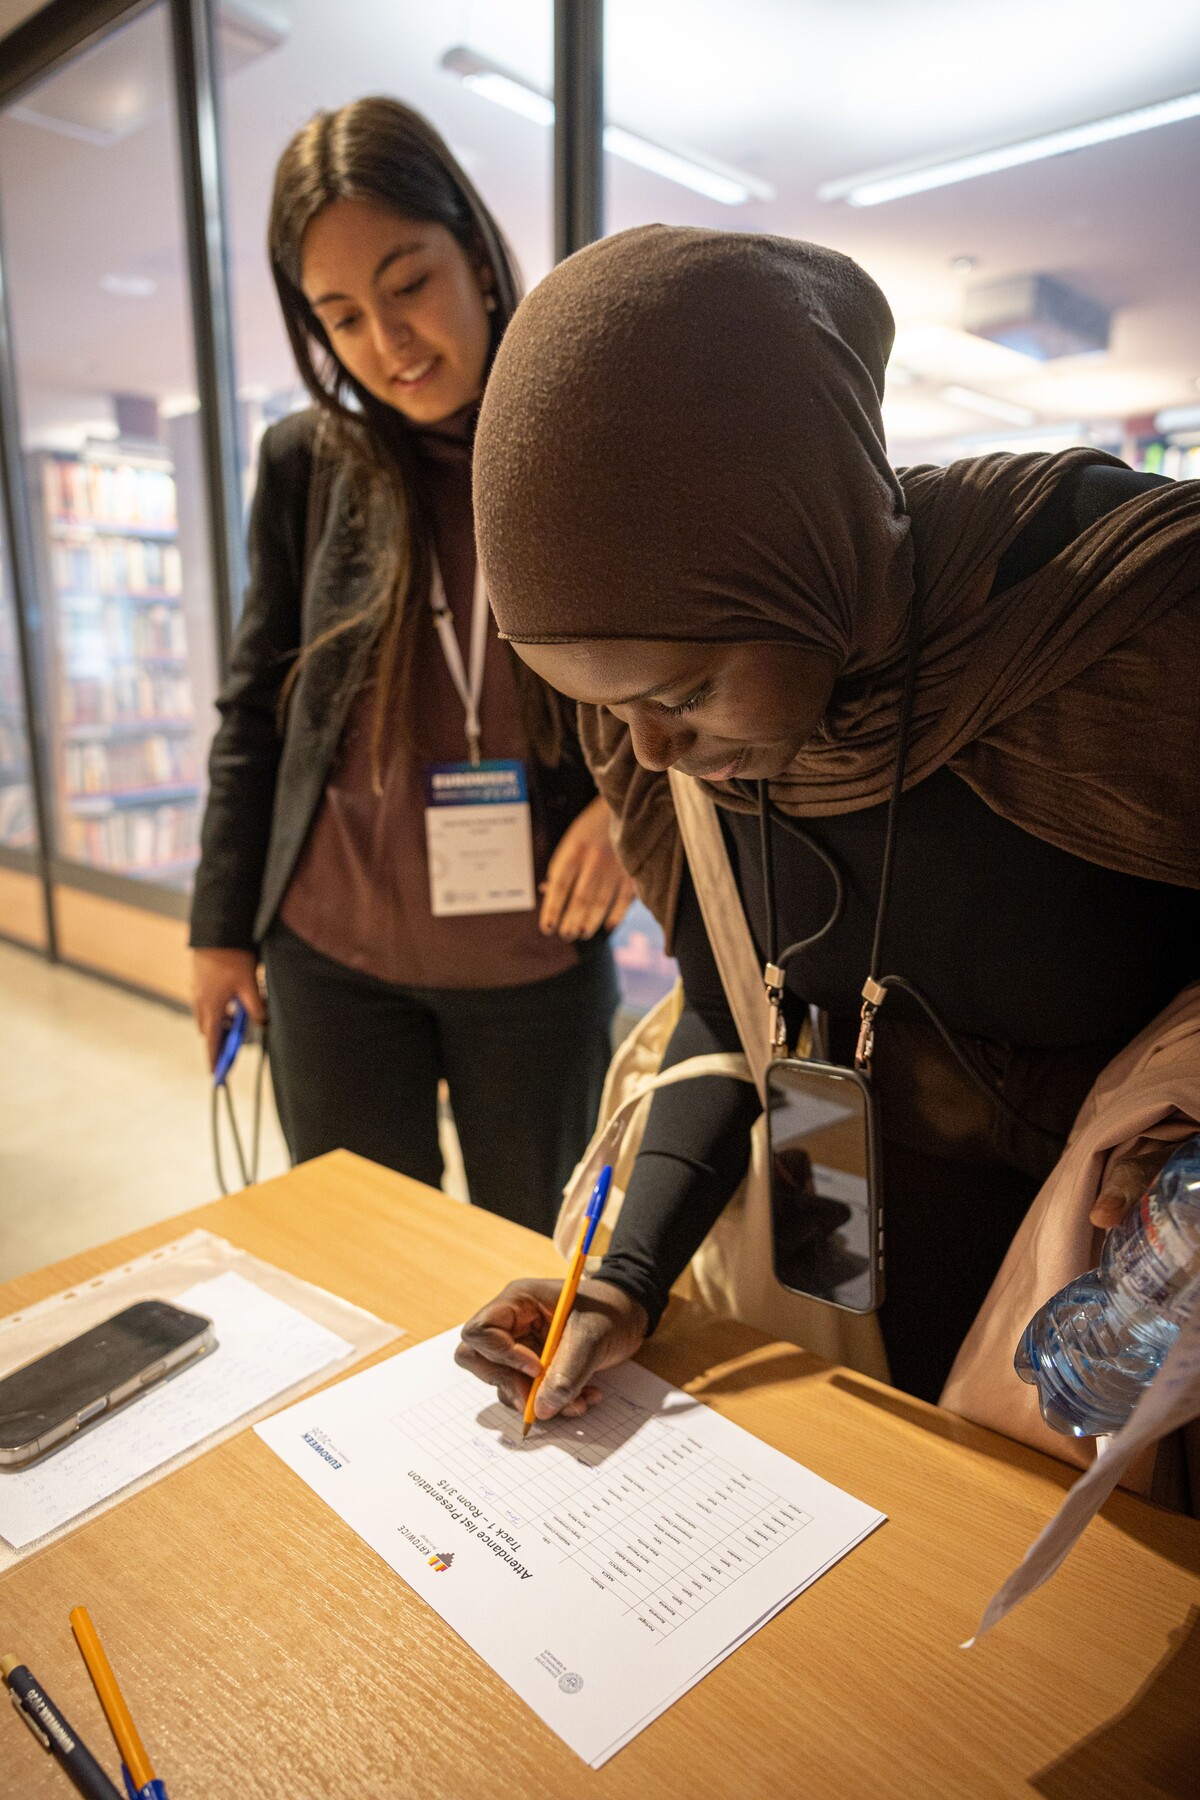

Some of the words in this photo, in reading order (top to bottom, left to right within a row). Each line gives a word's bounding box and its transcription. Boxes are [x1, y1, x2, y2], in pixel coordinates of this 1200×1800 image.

[301, 1432, 342, 1470] EUROWEEK
[436, 1479, 458, 1496] 3/15
[407, 1470, 463, 1520] Presentation
[456, 1494, 483, 1518] Room
[771, 1516, 786, 1527] Sweden
[779, 1510, 794, 1521] Sweden
[459, 1517, 478, 1533] list
[762, 1523, 777, 1534] Sweden
[397, 1525, 431, 1556] KATOWICE
[495, 1528, 521, 1552] Track
[753, 1529, 769, 1541] Sweden
[744, 1536, 760, 1548] Sweden
[476, 1531, 533, 1579] Attendance
[726, 1550, 742, 1562] Sweden
[719, 1558, 731, 1567] Spain
[710, 1565, 721, 1575] Spain
[701, 1573, 712, 1582] Spain
[691, 1580, 703, 1590] Spain
[681, 1587, 693, 1597] Spain
[671, 1594, 683, 1605] Spain
[658, 1601, 676, 1616] Romania
[648, 1609, 666, 1624] Romania
[637, 1617, 655, 1632] Portugal
